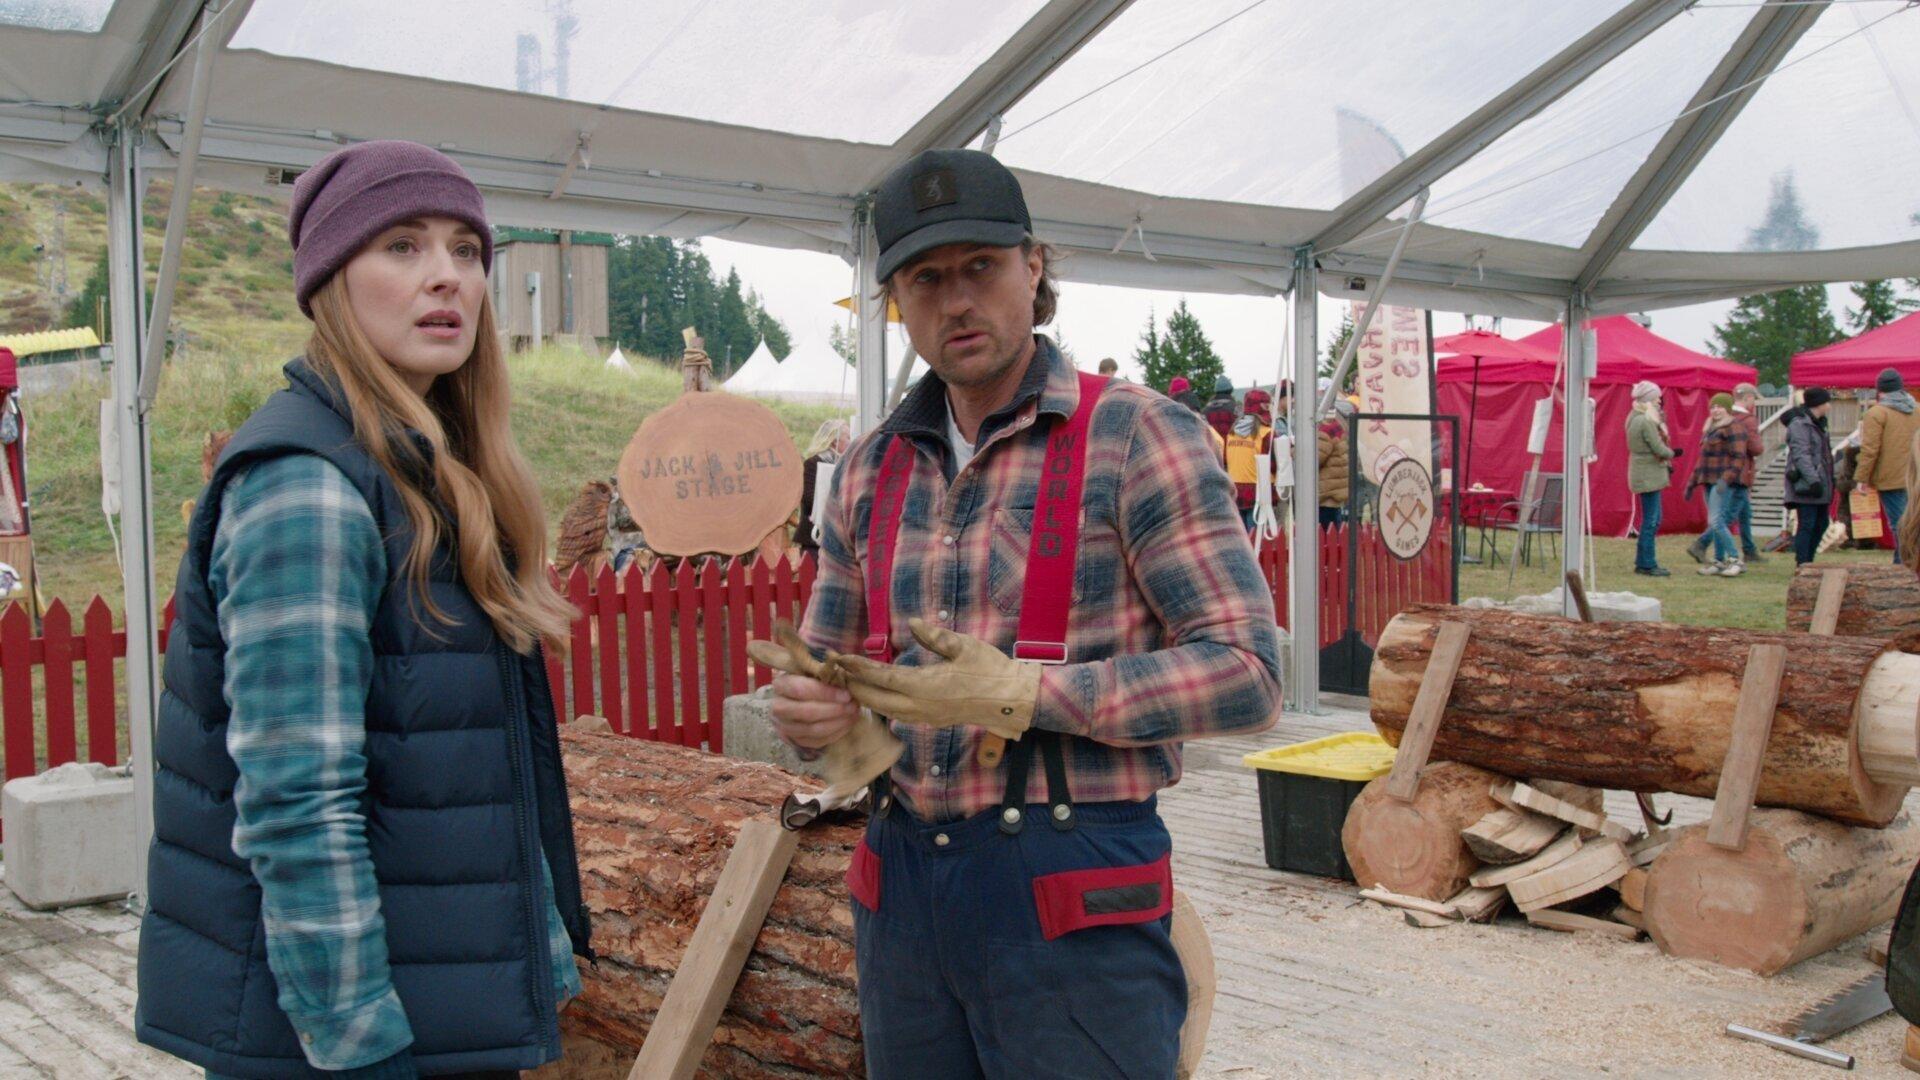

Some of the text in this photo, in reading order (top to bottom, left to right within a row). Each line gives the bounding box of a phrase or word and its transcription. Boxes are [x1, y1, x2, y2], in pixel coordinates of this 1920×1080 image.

[641, 455, 696, 479] JACK
[735, 448, 782, 471] JILL
[676, 475, 750, 499] STAGE
[1038, 435, 1077, 557] WORLD
